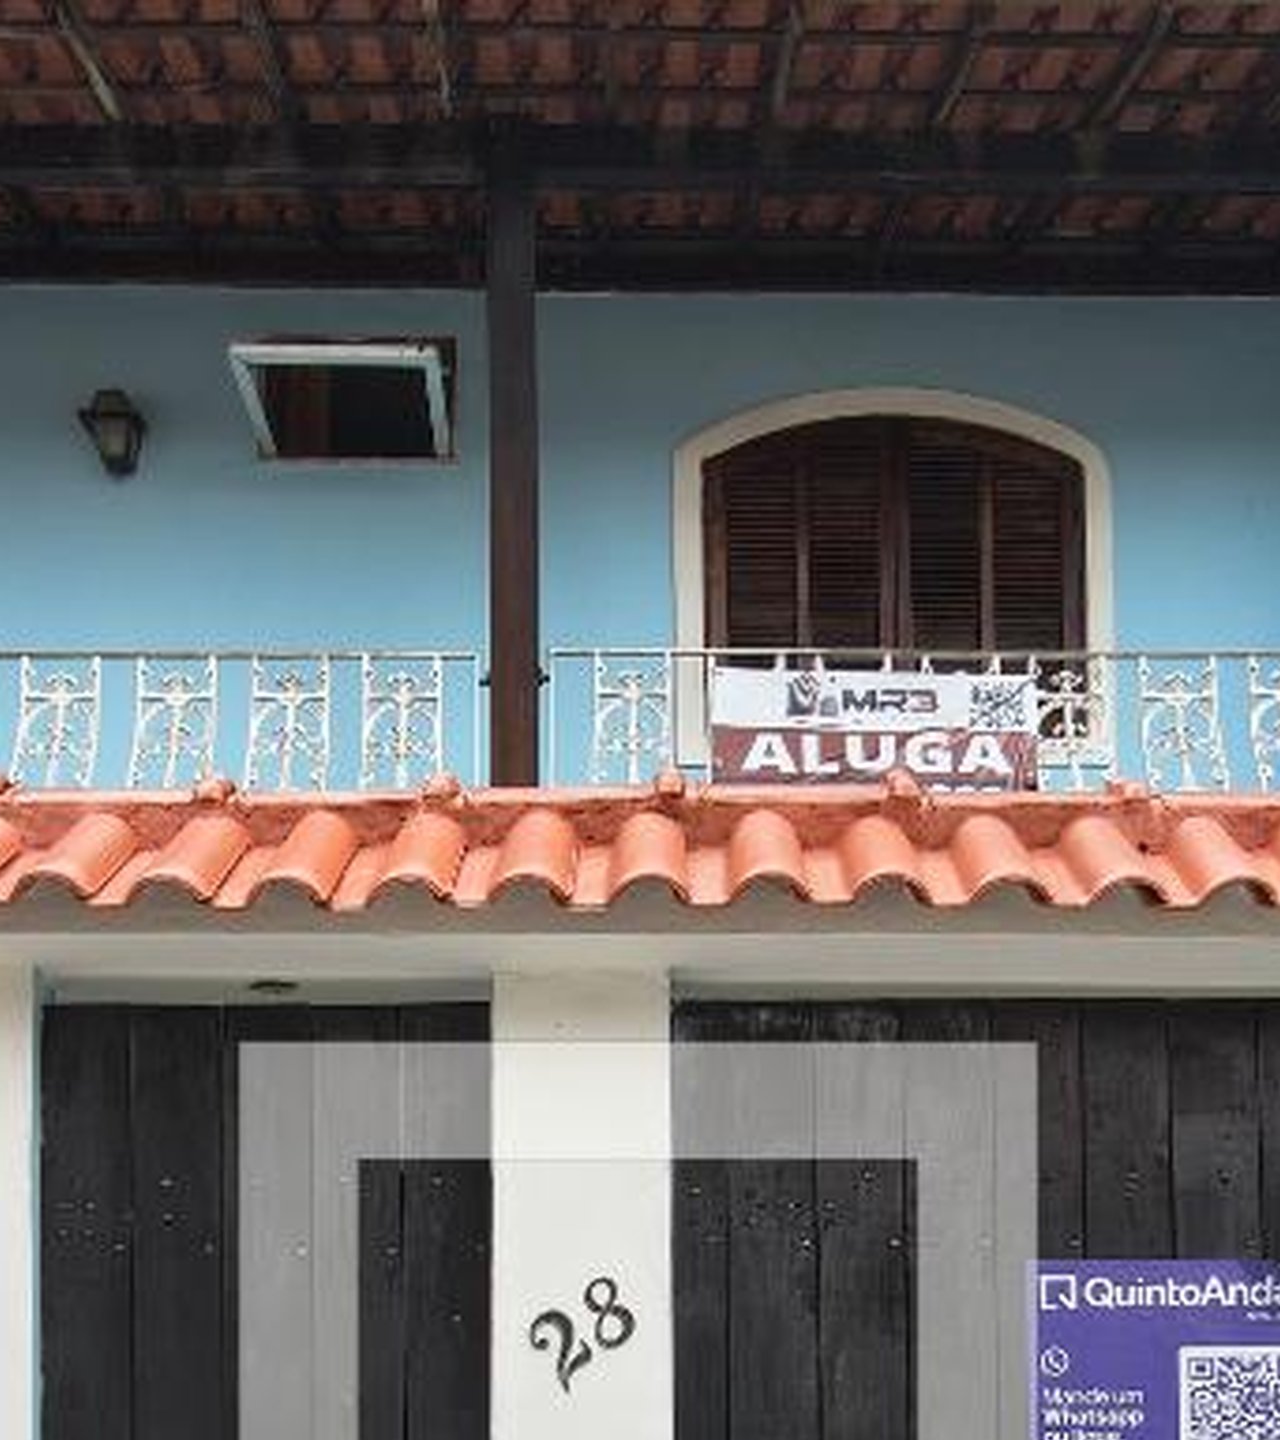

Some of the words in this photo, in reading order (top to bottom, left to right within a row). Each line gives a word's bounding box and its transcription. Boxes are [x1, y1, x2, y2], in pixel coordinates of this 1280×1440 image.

[841, 688, 940, 714] MR3
[740, 733, 1013, 774] ALUGA
[530, 1276, 637, 1393] 28
